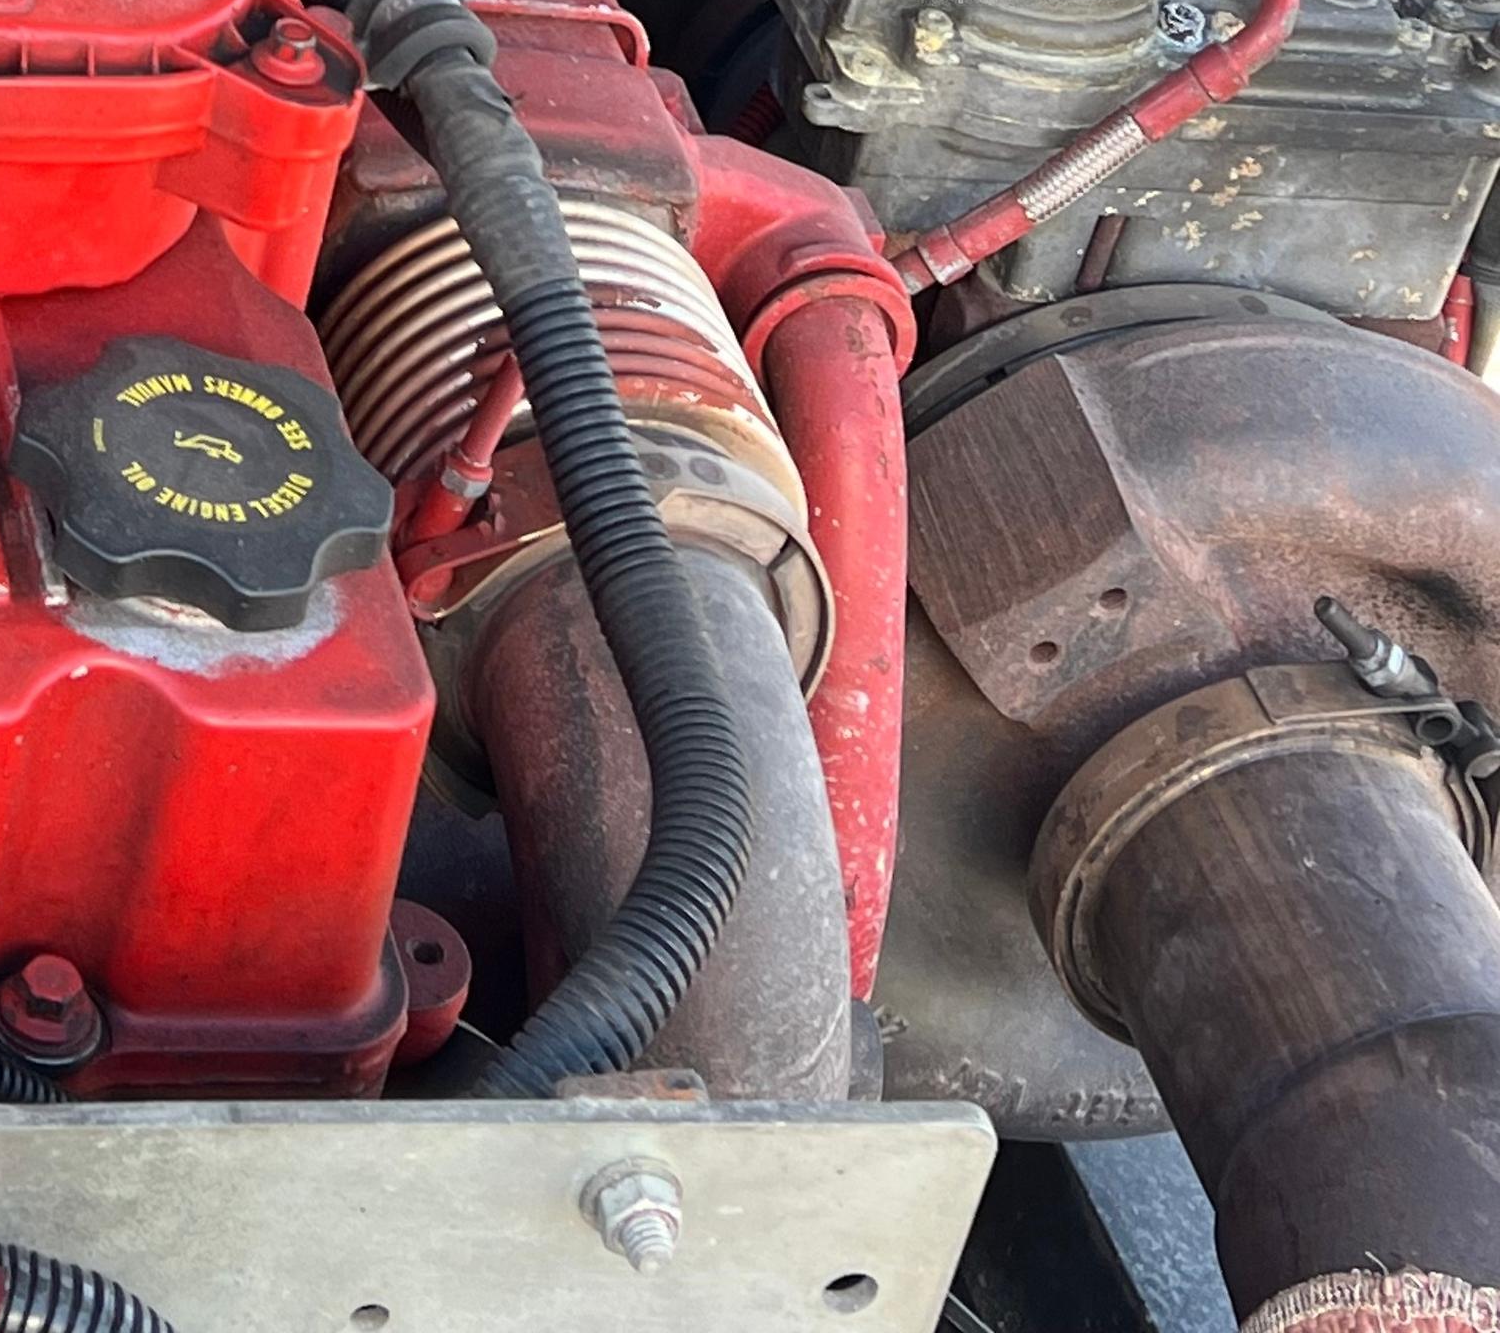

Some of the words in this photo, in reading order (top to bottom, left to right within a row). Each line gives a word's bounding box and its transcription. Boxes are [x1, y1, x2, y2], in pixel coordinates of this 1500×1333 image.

[116, 373, 193, 408] MANUAL
[203, 375, 285, 420] OWNERS
[276, 419, 312, 450] SEE
[121, 461, 156, 492] OIL
[154, 486, 247, 523] ENGINE
[247, 472, 314, 519] DIESEL
